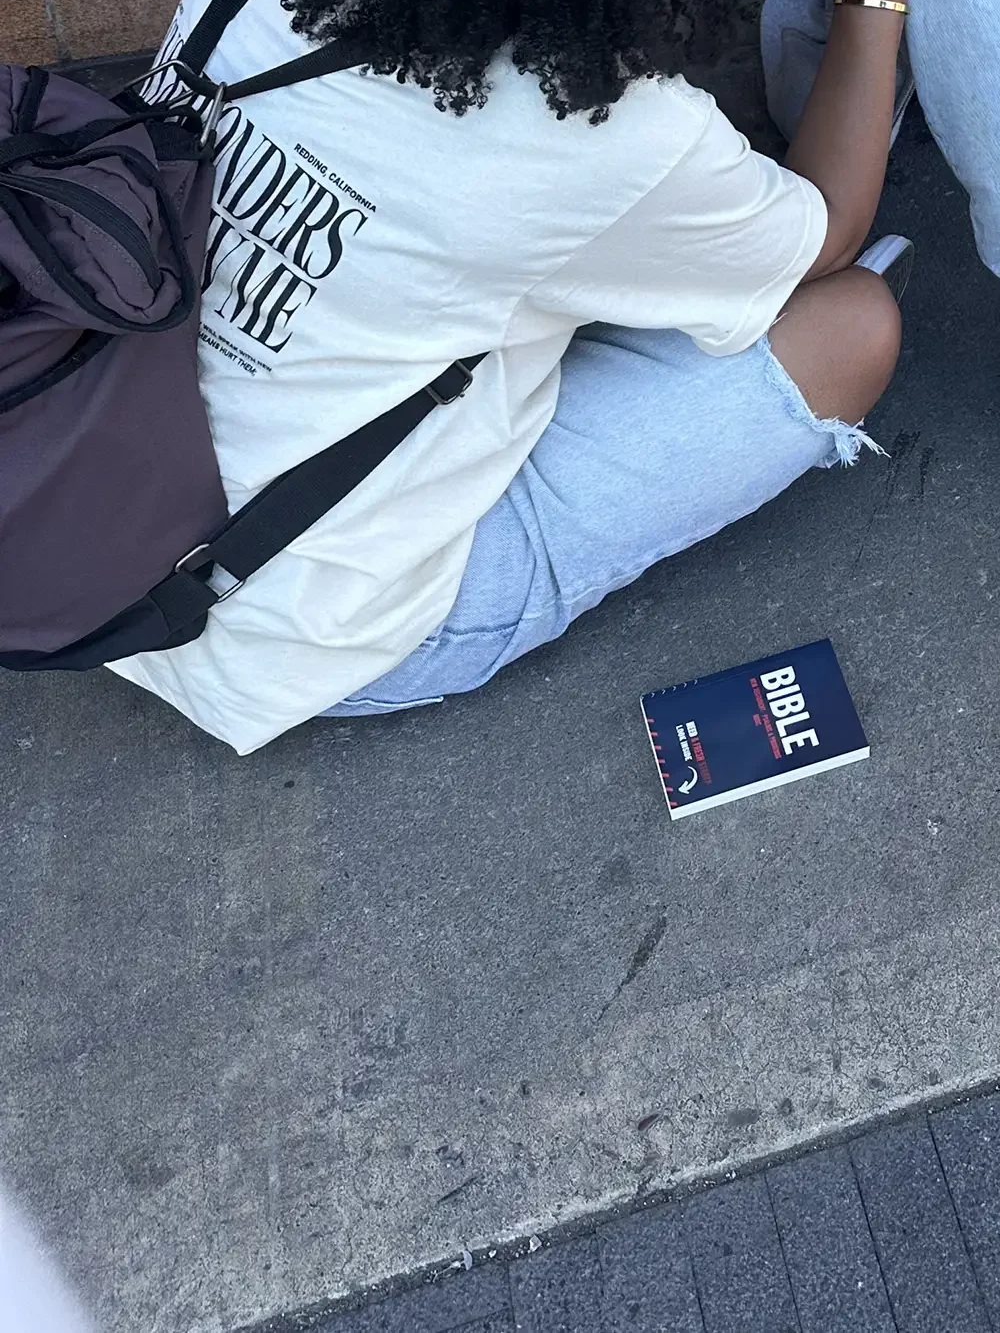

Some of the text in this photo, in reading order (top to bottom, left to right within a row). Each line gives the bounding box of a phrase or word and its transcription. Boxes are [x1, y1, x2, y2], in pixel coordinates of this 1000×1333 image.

[200, 102, 368, 279] ONDERS
[294, 143, 377, 212] REDDING, CALIFORNIA
[220, 346, 238, 361] HURT
[676, 724, 693, 762] LOOK INSIDE
[760, 666, 819, 755] BIBLE
